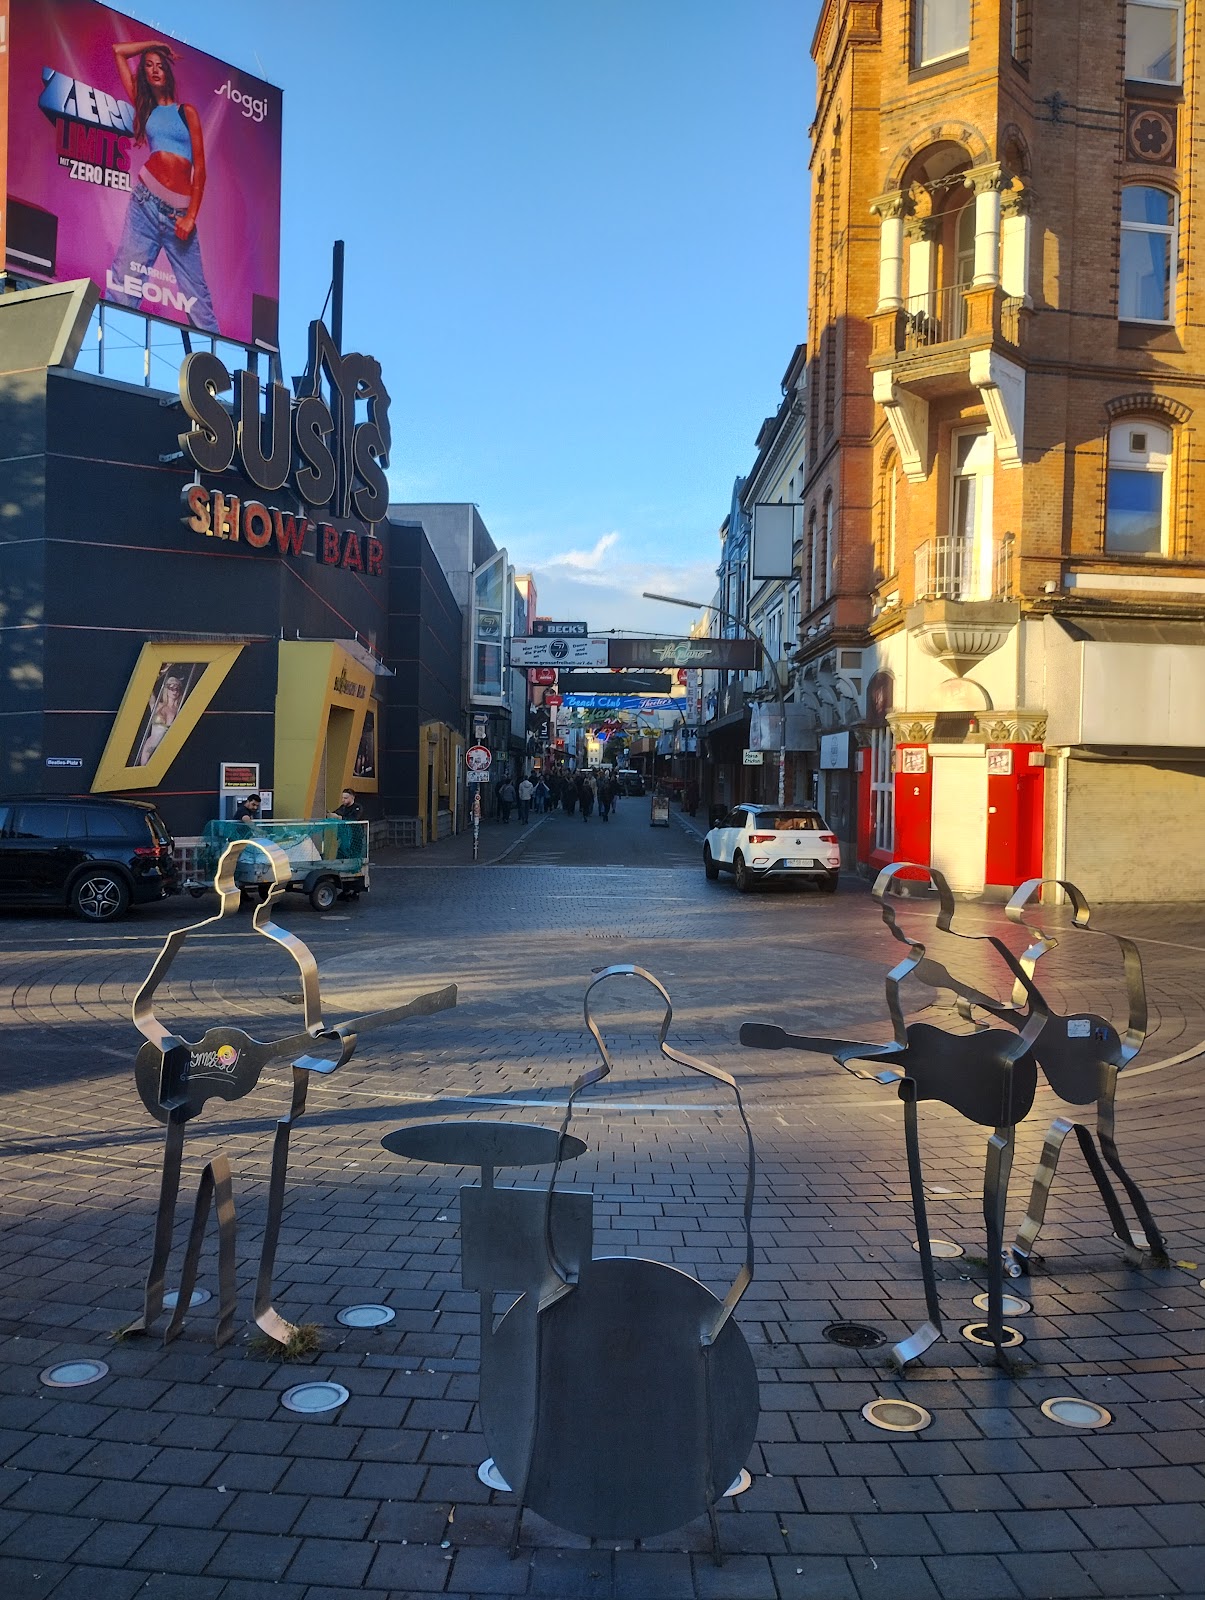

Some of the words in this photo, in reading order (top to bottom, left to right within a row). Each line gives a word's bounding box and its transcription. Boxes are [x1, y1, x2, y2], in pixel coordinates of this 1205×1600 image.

[39, 66, 135, 132] ZERO
[214, 80, 268, 122] sloggi
[56, 118, 132, 171] LIMITS
[59, 157, 71, 167] MIT
[69, 160, 103, 185] ZERO
[104, 168, 132, 193] FEEL
[106, 269, 198, 314] LEONY
[129, 261, 177, 284] STARRING
[181, 483, 309, 557] SHOW
[316, 521, 384, 576] BAR
[547, 625, 585, 633] BECK'S
[566, 696, 596, 707] Beach
[597, 697, 621, 707] Club
[913, 787, 920, 796] 2
